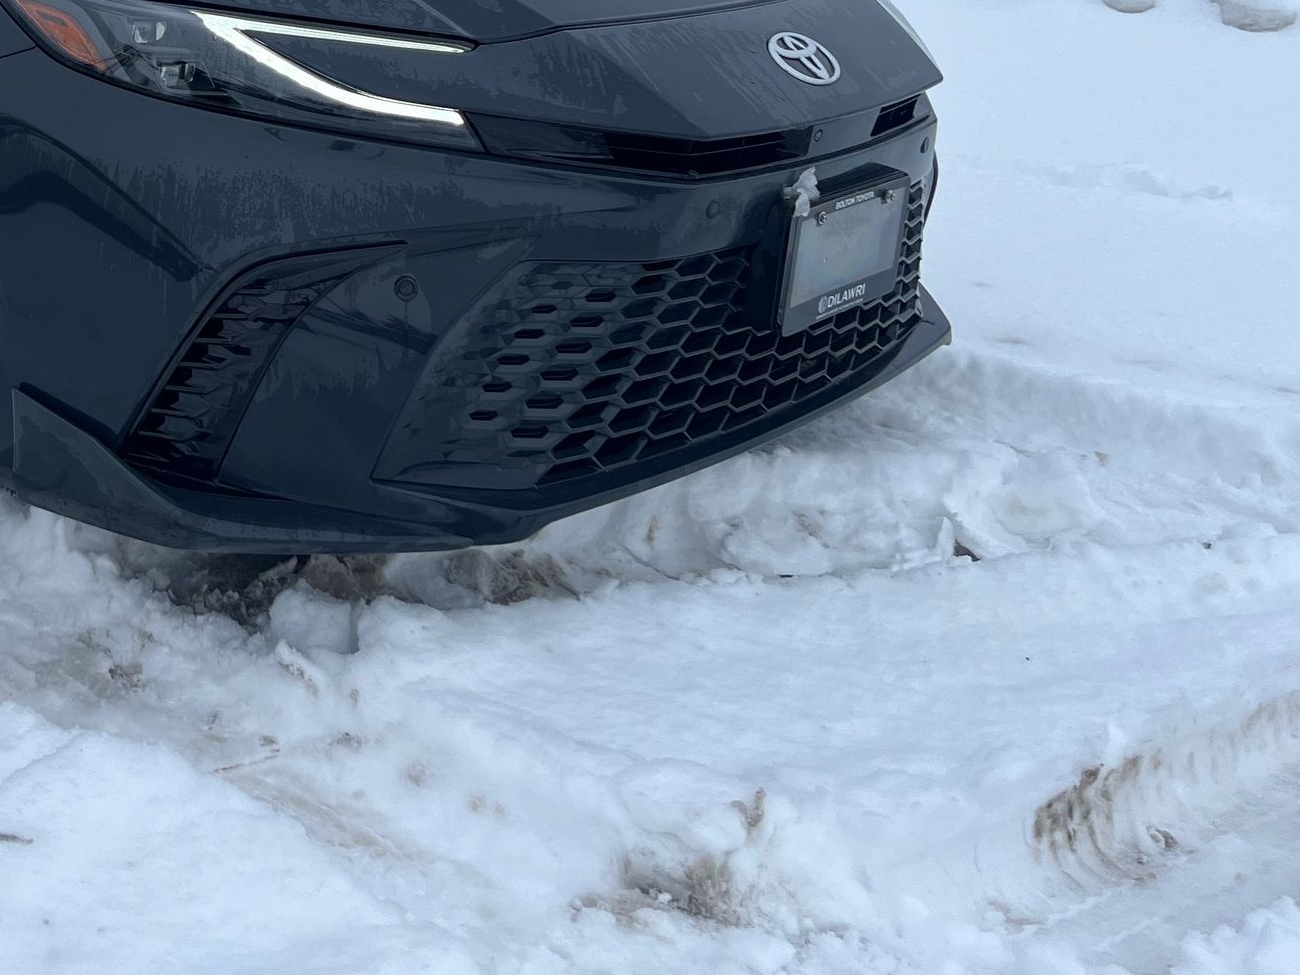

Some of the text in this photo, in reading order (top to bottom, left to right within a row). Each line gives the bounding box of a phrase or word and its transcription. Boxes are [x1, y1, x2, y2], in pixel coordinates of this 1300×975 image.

[835, 191, 874, 210] BOLTON TOYOTA
[827, 283, 866, 308] DILAWRI
